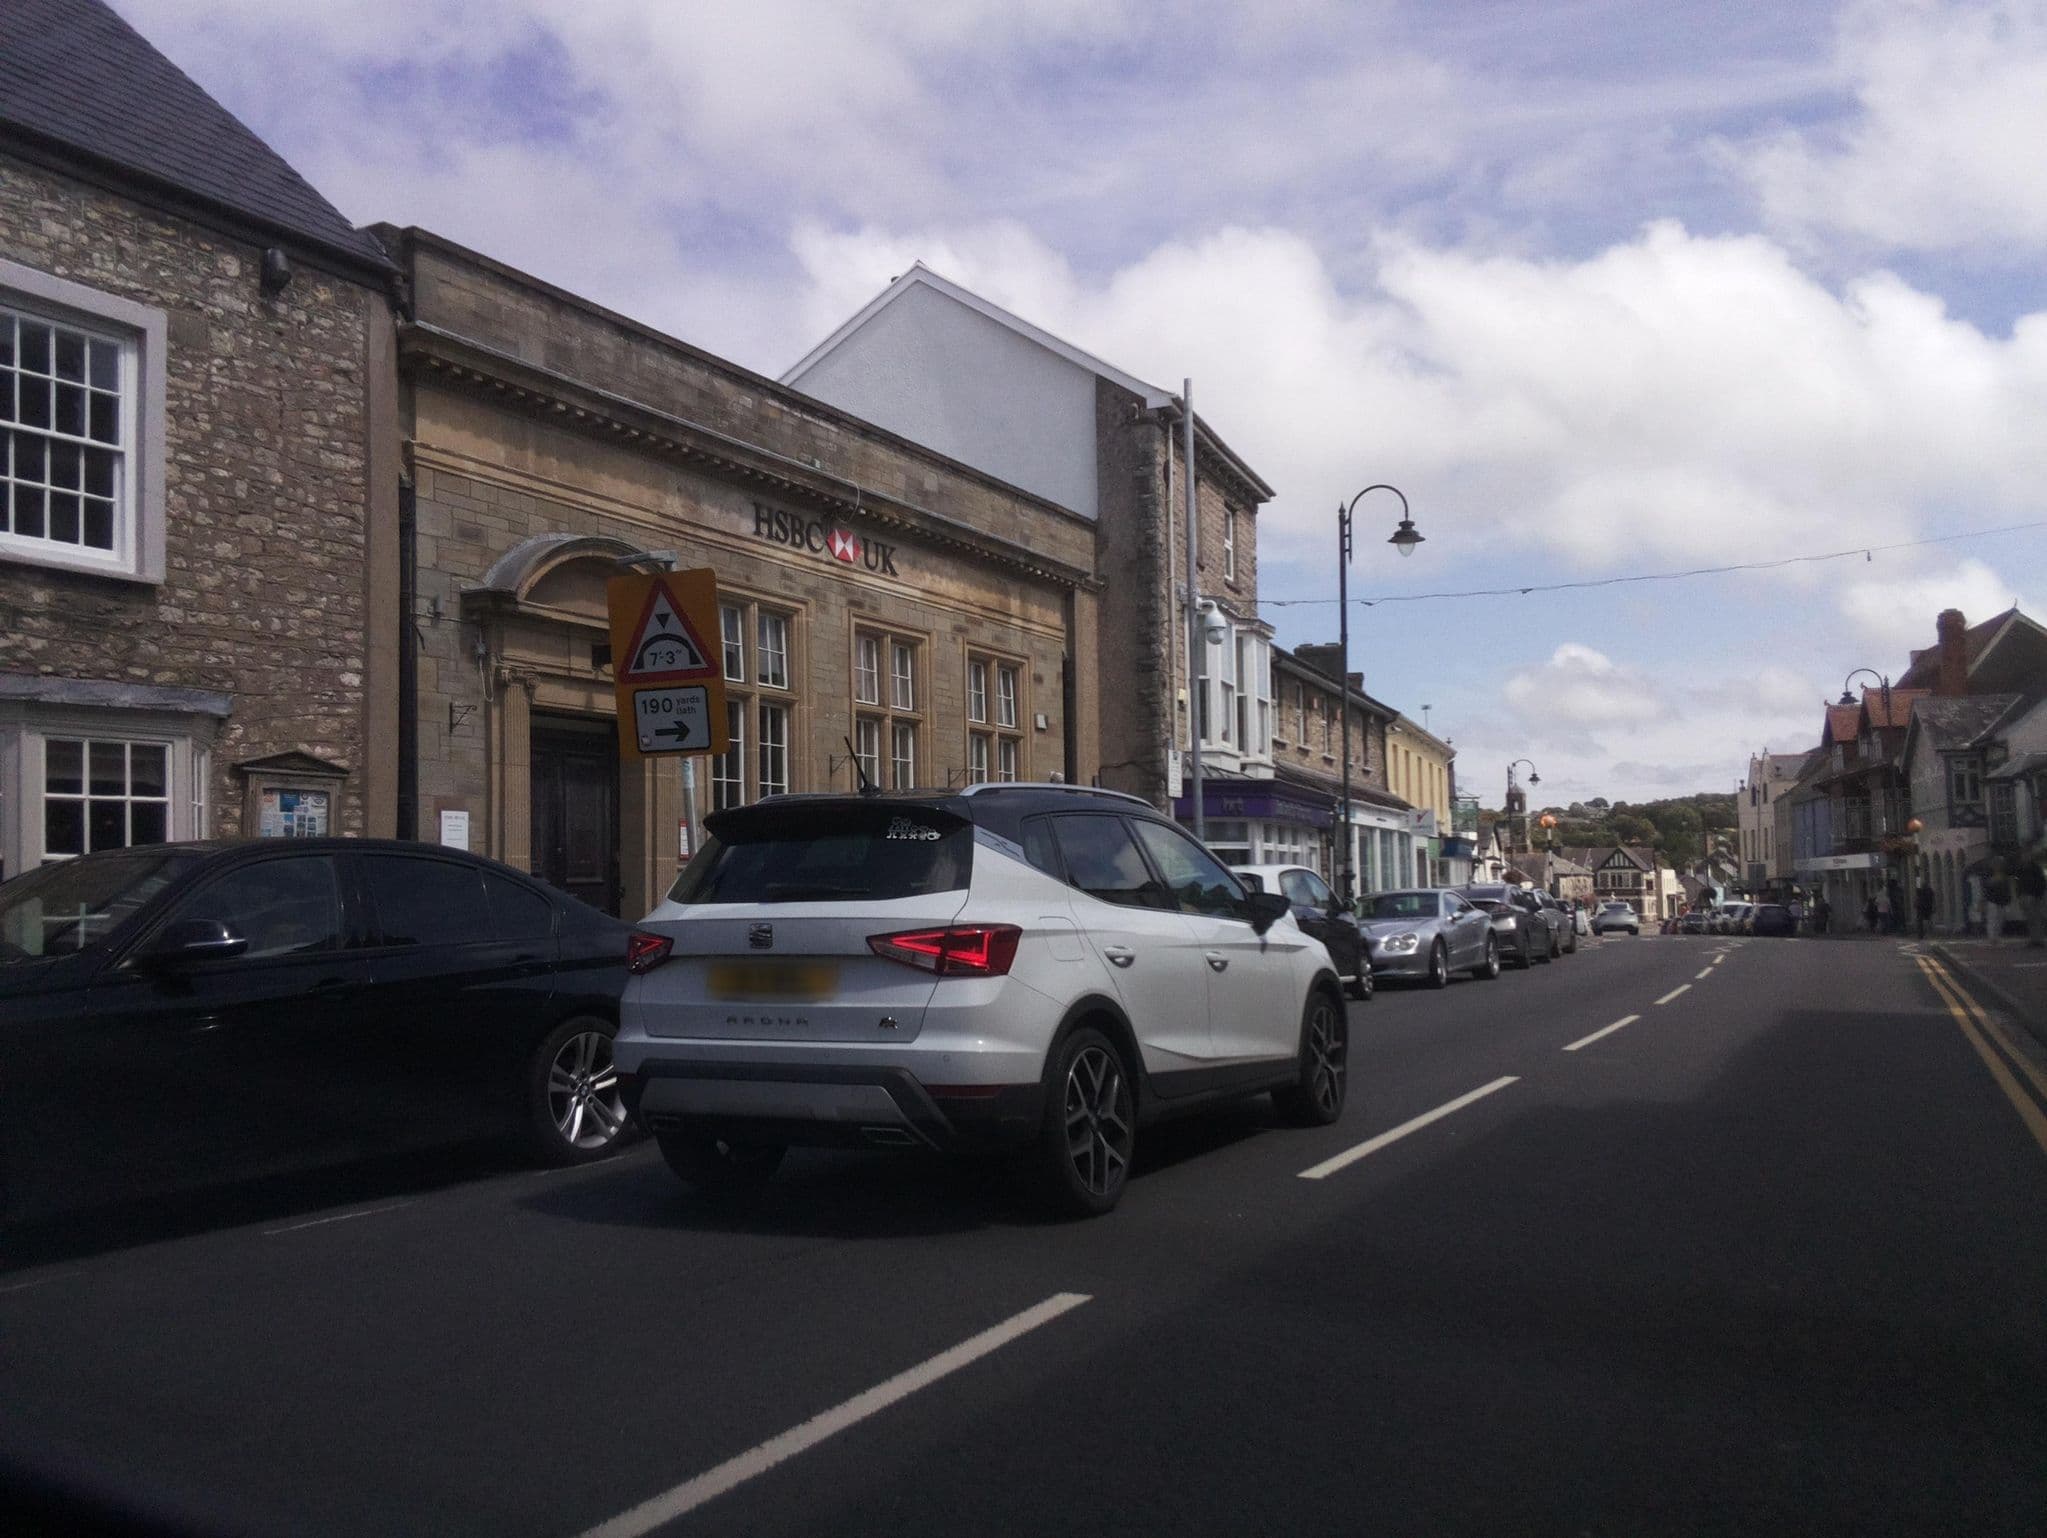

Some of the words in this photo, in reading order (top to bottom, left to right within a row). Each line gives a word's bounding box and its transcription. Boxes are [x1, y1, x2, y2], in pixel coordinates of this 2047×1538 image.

[753, 502, 824, 554] HSBC
[863, 538, 898, 576] UK
[641, 696, 673, 715] 190
